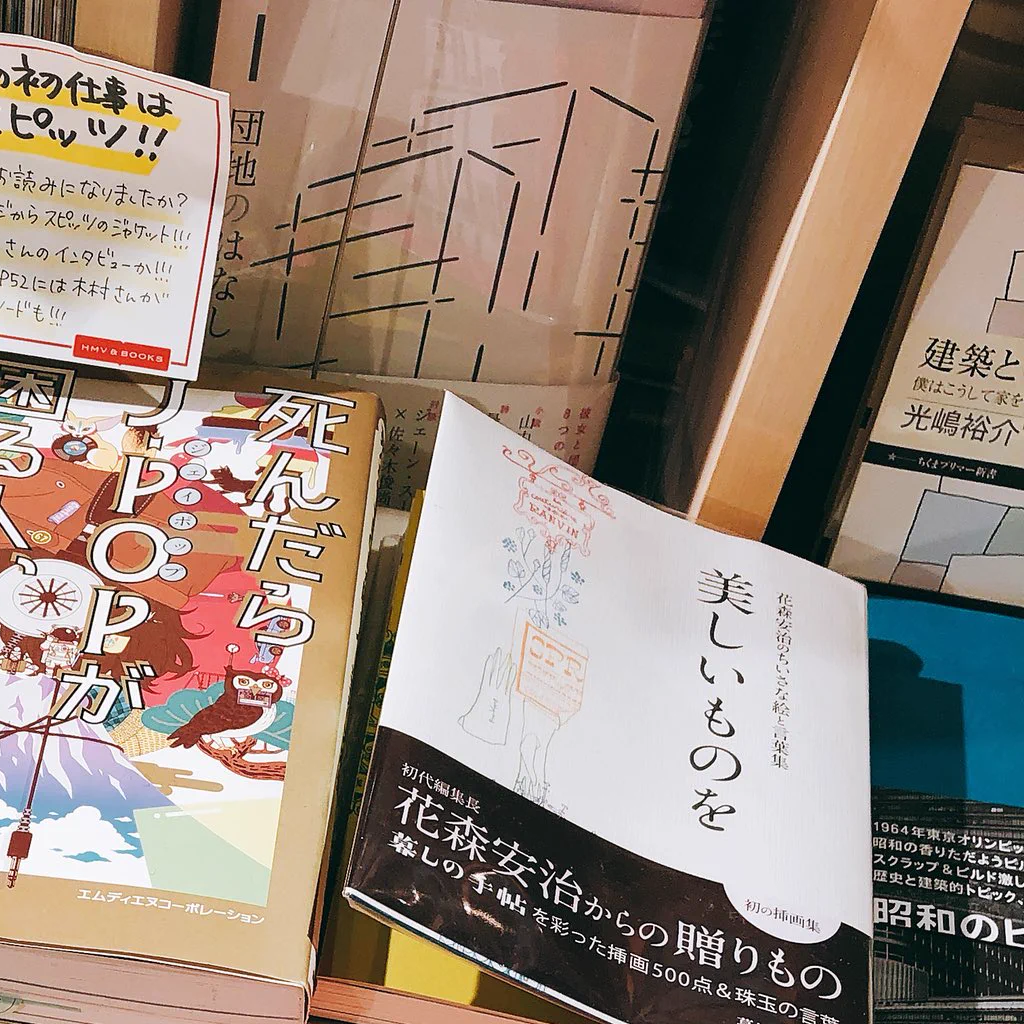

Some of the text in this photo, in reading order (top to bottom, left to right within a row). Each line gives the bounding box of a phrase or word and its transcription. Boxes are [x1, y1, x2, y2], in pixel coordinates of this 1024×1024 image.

[80, 342, 164, 364] HMV & BOOKS
[916, 336, 1021, 381] 建築と
[900, 403, 1020, 447] 光嶋裕介
[237, 386, 356, 648] 死んだら
[688, 567, 755, 834] 美しいものを
[400, 762, 481, 812] 初代編集長
[872, 837, 1024, 871] 昭和の香りただようビ
[77, 889, 265, 925] エムディエヌコーポレーション
[393, 783, 843, 1001] 花森安治からの贈りもの
[744, 898, 822, 935] 初の挿画集
